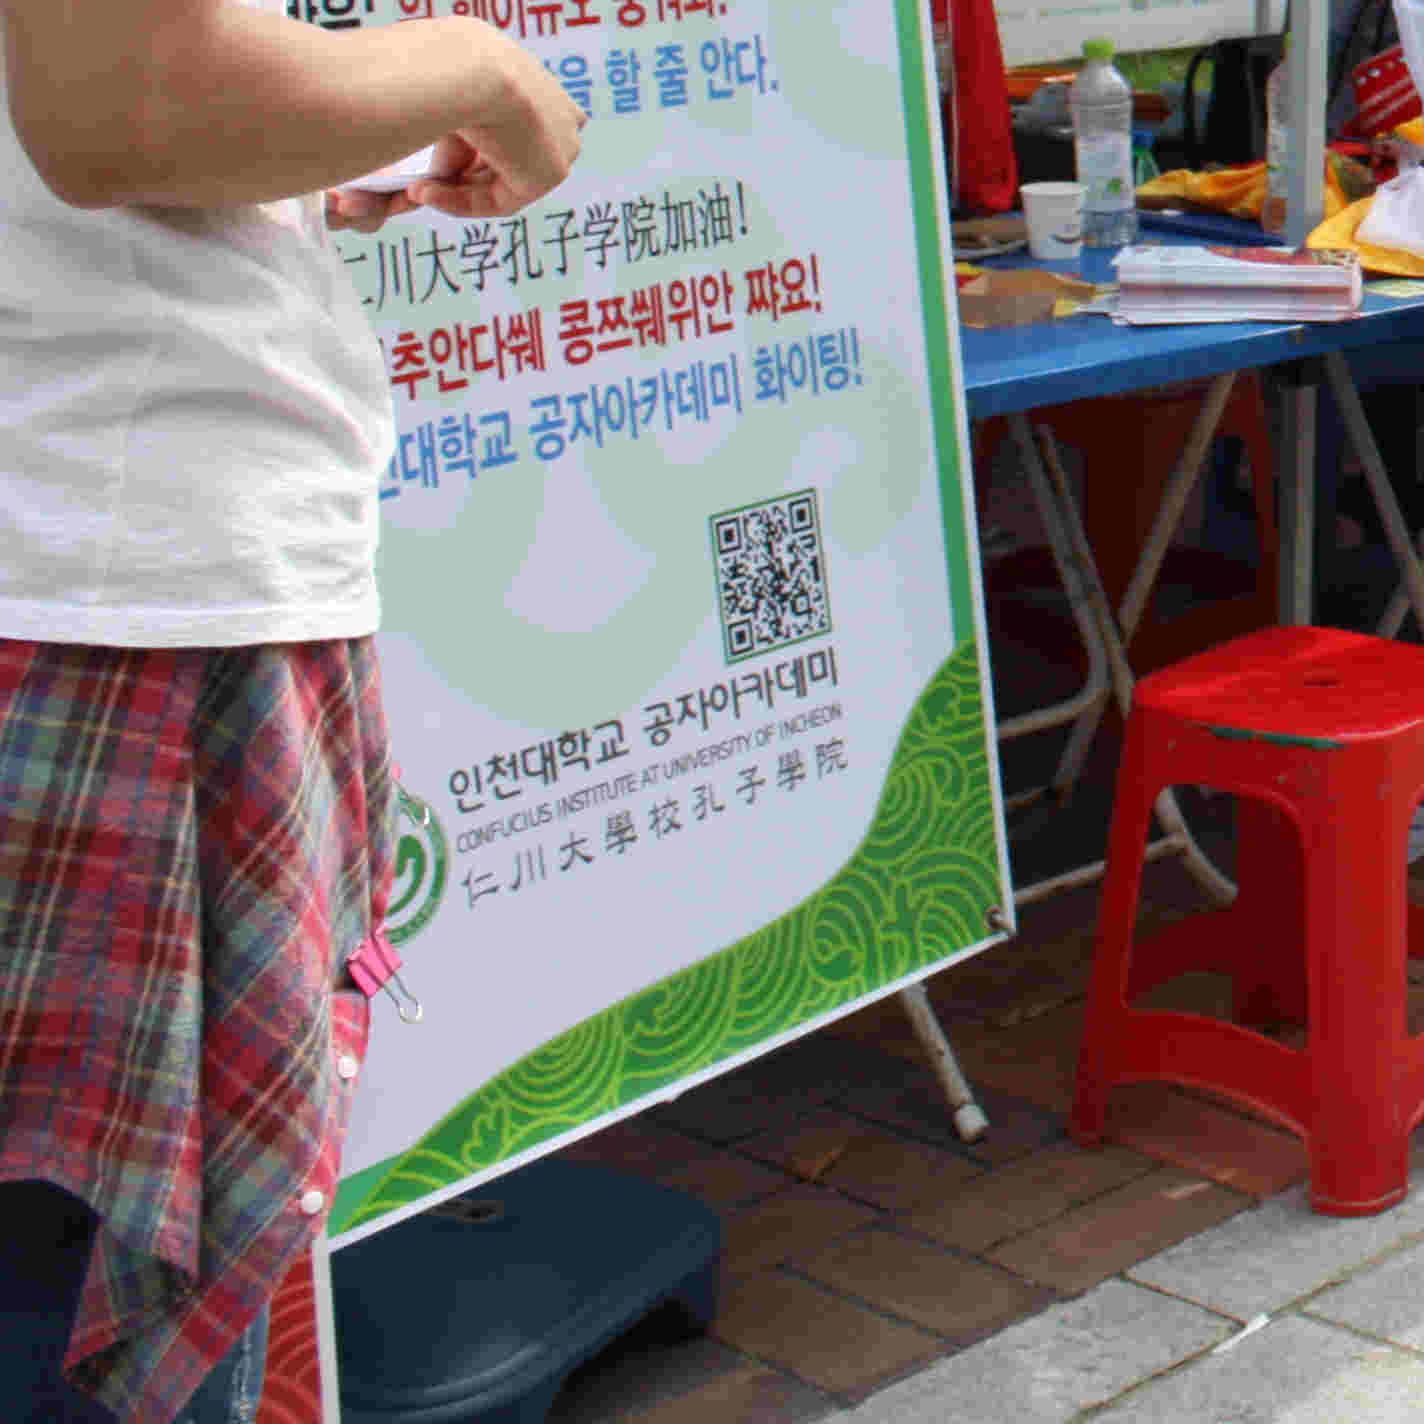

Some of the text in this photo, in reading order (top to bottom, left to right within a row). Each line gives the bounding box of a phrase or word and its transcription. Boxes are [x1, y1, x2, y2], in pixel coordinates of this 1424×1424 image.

[605, 47, 641, 115] 할
[653, 43, 688, 109] 줄
[700, 34, 779, 106] 안다.
[379, 307, 546, 401] 추안다쒜
[744, 253, 822, 321] 쨔요!
[529, 353, 743, 462] 공자아카데미
[753, 327, 864, 403] 화이팅!
[449, 646, 838, 814] 인천대학교 공자아카데미
[456, 703, 842, 854] CONFUCIUS INSTITUTE AT UNIVERSITY OF INCHEON
[461, 737, 848, 909] 仁川大學校孔子學院
